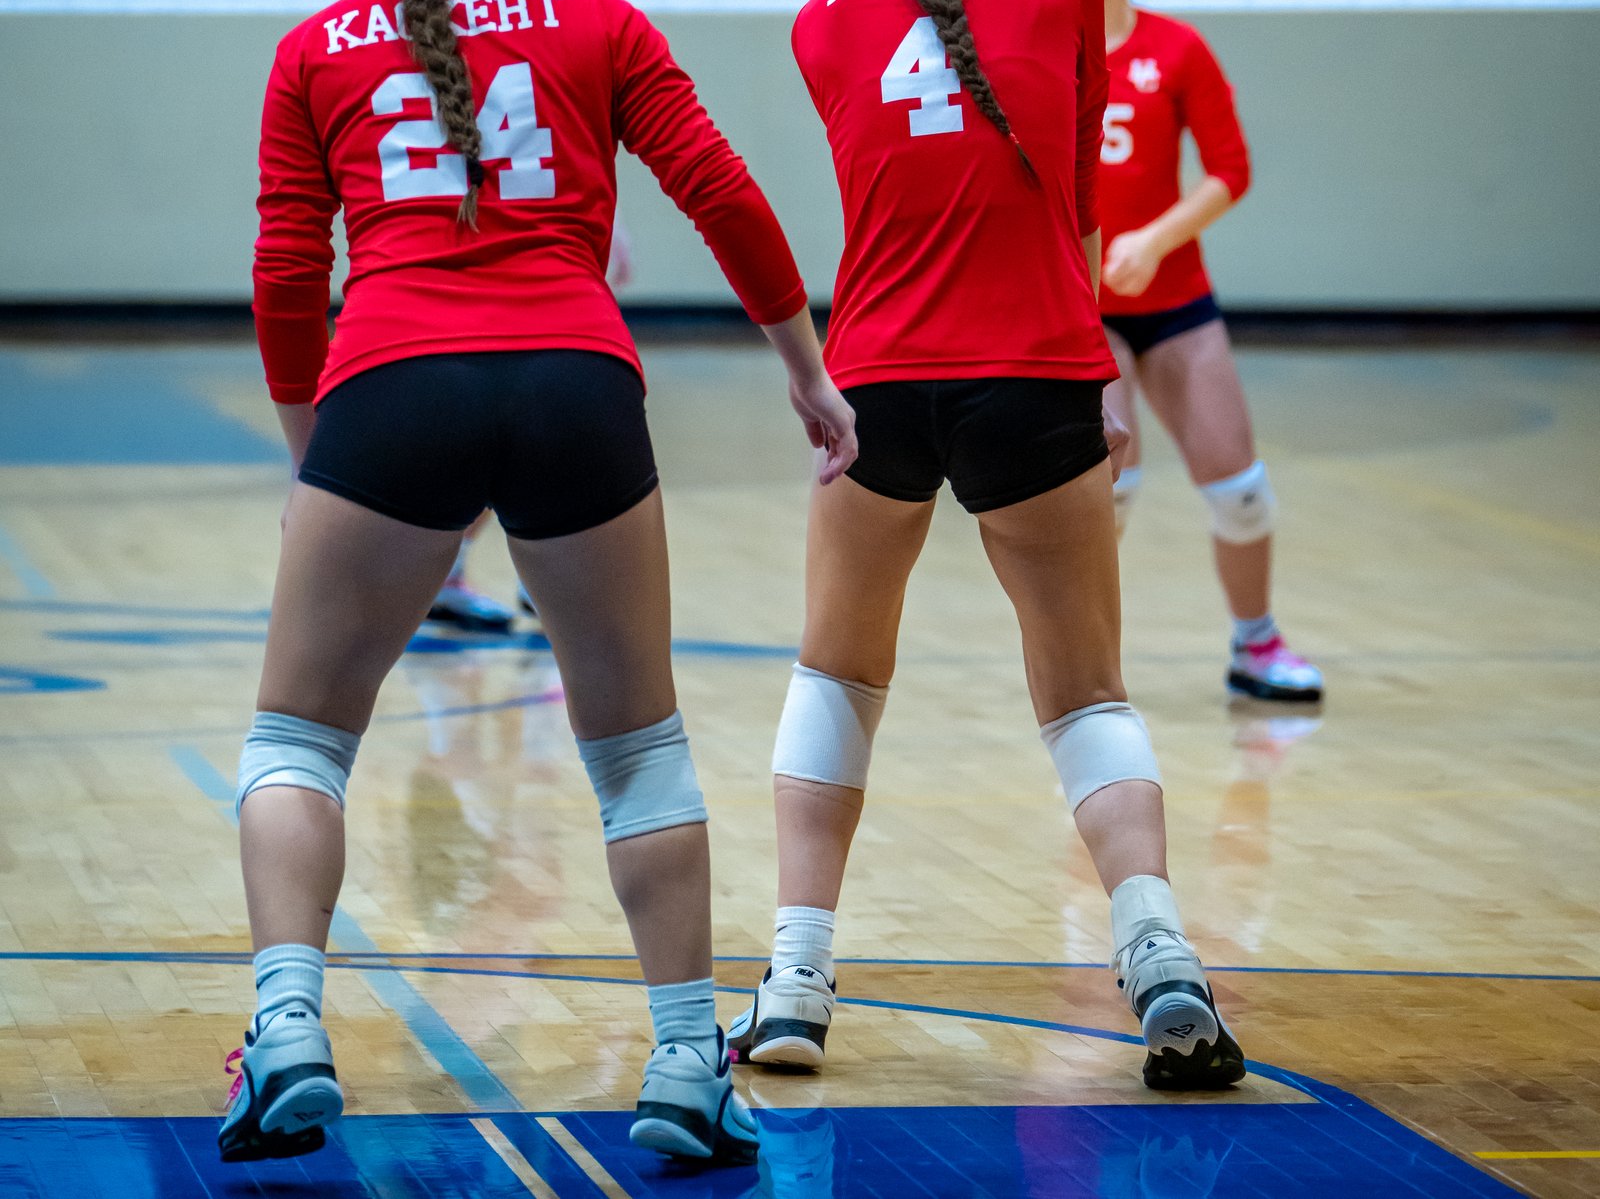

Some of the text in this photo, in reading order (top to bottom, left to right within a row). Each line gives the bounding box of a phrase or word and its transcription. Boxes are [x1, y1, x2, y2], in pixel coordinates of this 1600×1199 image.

[880, 15, 964, 137] 4
[371, 62, 556, 202] 24
[1099, 102, 1136, 166] 5
[795, 967, 815, 978] FREAK
